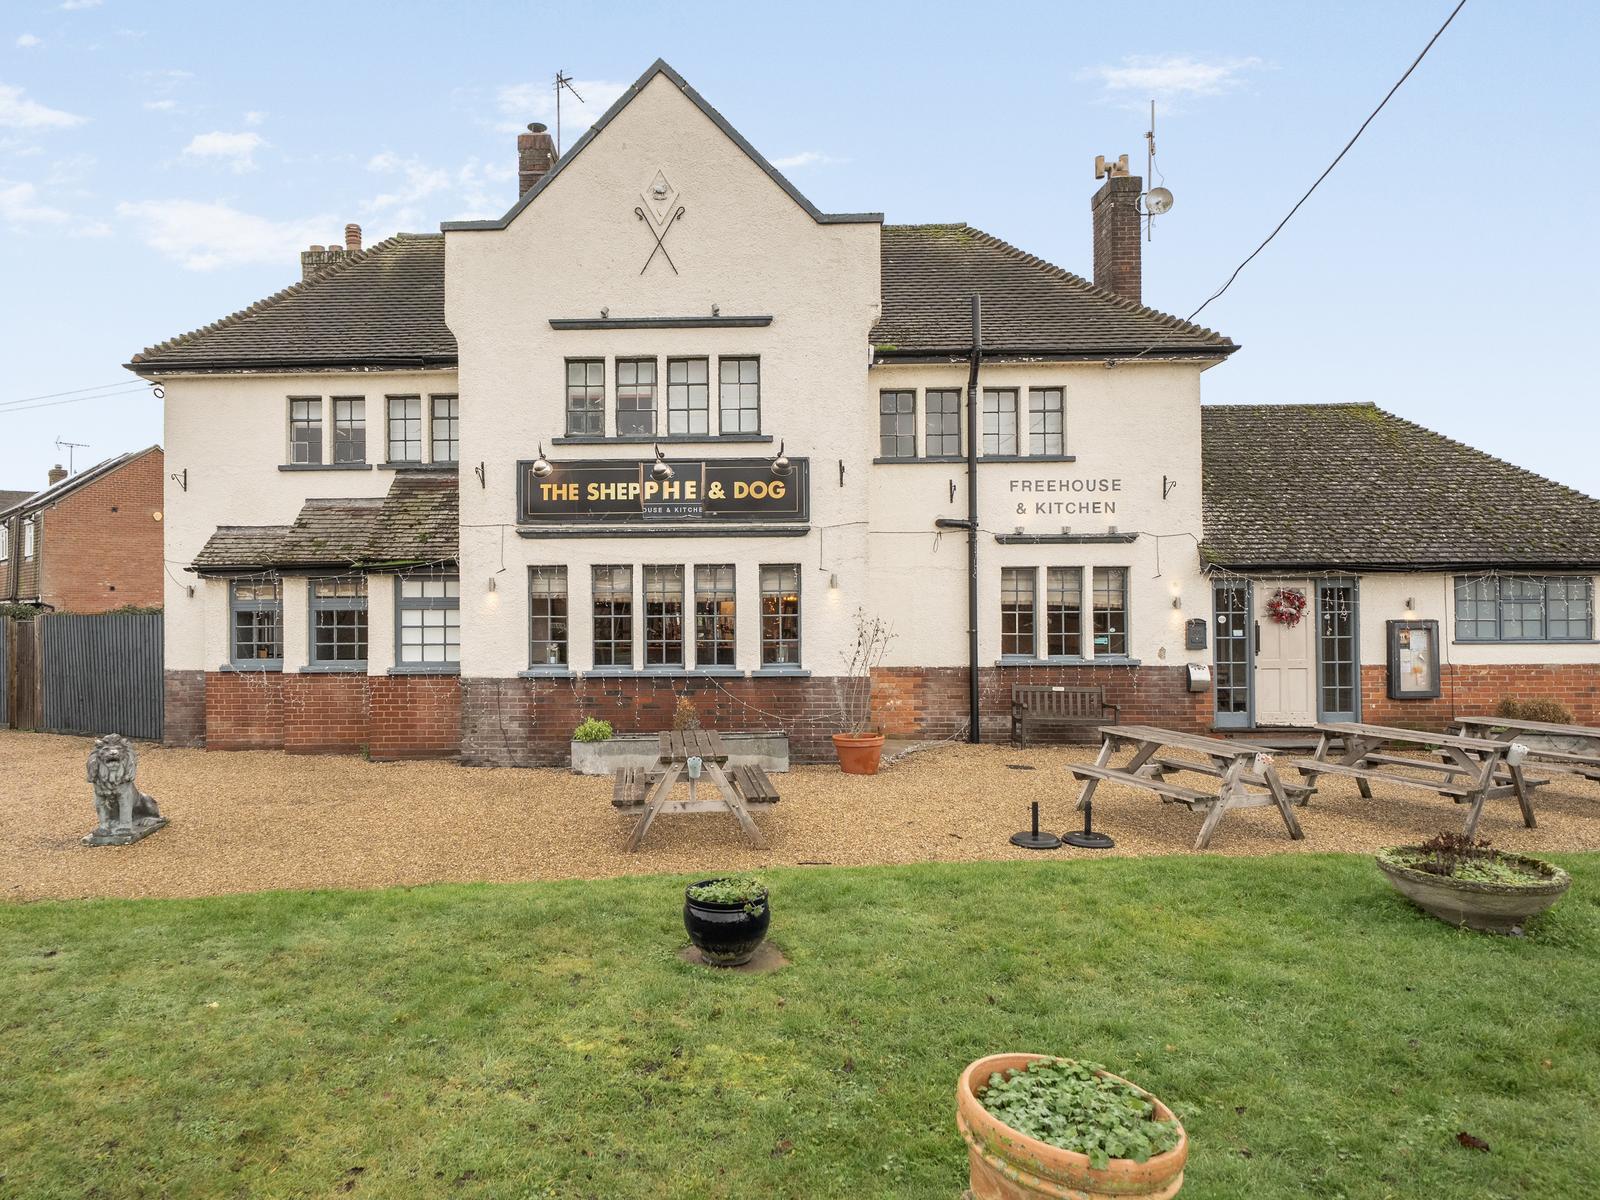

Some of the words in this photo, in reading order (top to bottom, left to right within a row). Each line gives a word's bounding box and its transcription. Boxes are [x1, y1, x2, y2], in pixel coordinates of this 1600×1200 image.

[540, 483, 579, 501] THE
[708, 481, 727, 500] &
[734, 481, 786, 500] DOG
[1009, 479, 1121, 492] FREEHOUSE
[1016, 502, 1027, 515] &
[1035, 501, 1116, 515] KITCHEN
